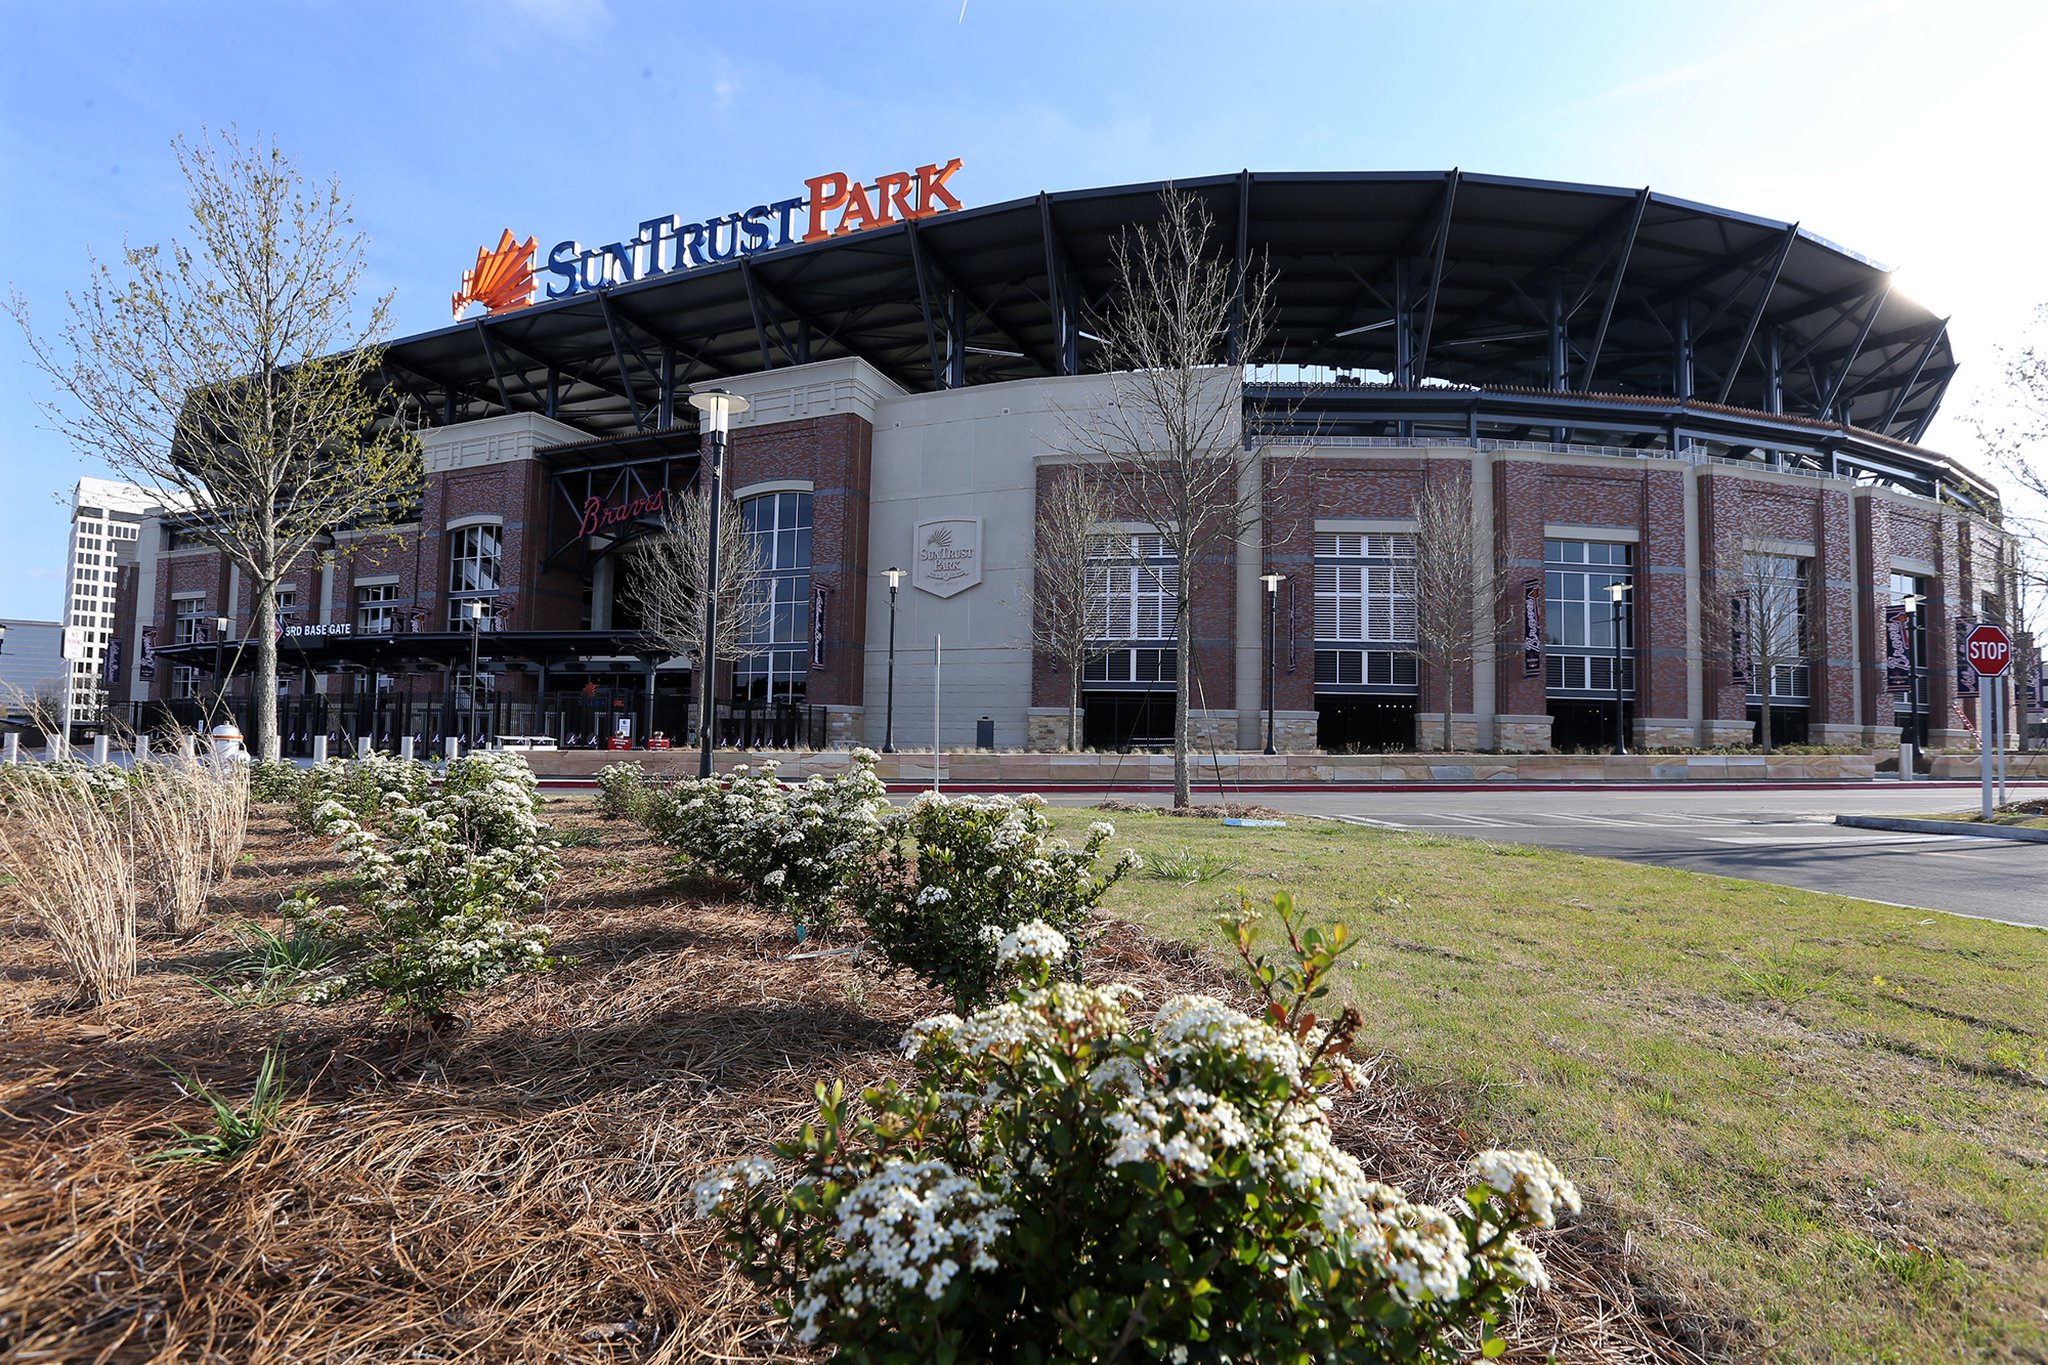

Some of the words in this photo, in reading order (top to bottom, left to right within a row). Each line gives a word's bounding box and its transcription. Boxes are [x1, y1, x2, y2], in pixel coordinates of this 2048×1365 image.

[803, 158, 964, 243] PARK
[578, 489, 664, 538] Braves
[934, 559, 961, 572] PARK
[285, 625, 302, 637] 3RD
[304, 624, 328, 636] BASE
[329, 623, 352, 635] GATE
[1525, 598, 1541, 652] Braves
[1886, 621, 1911, 671] Braves
[1970, 641, 2008, 660] STOP
